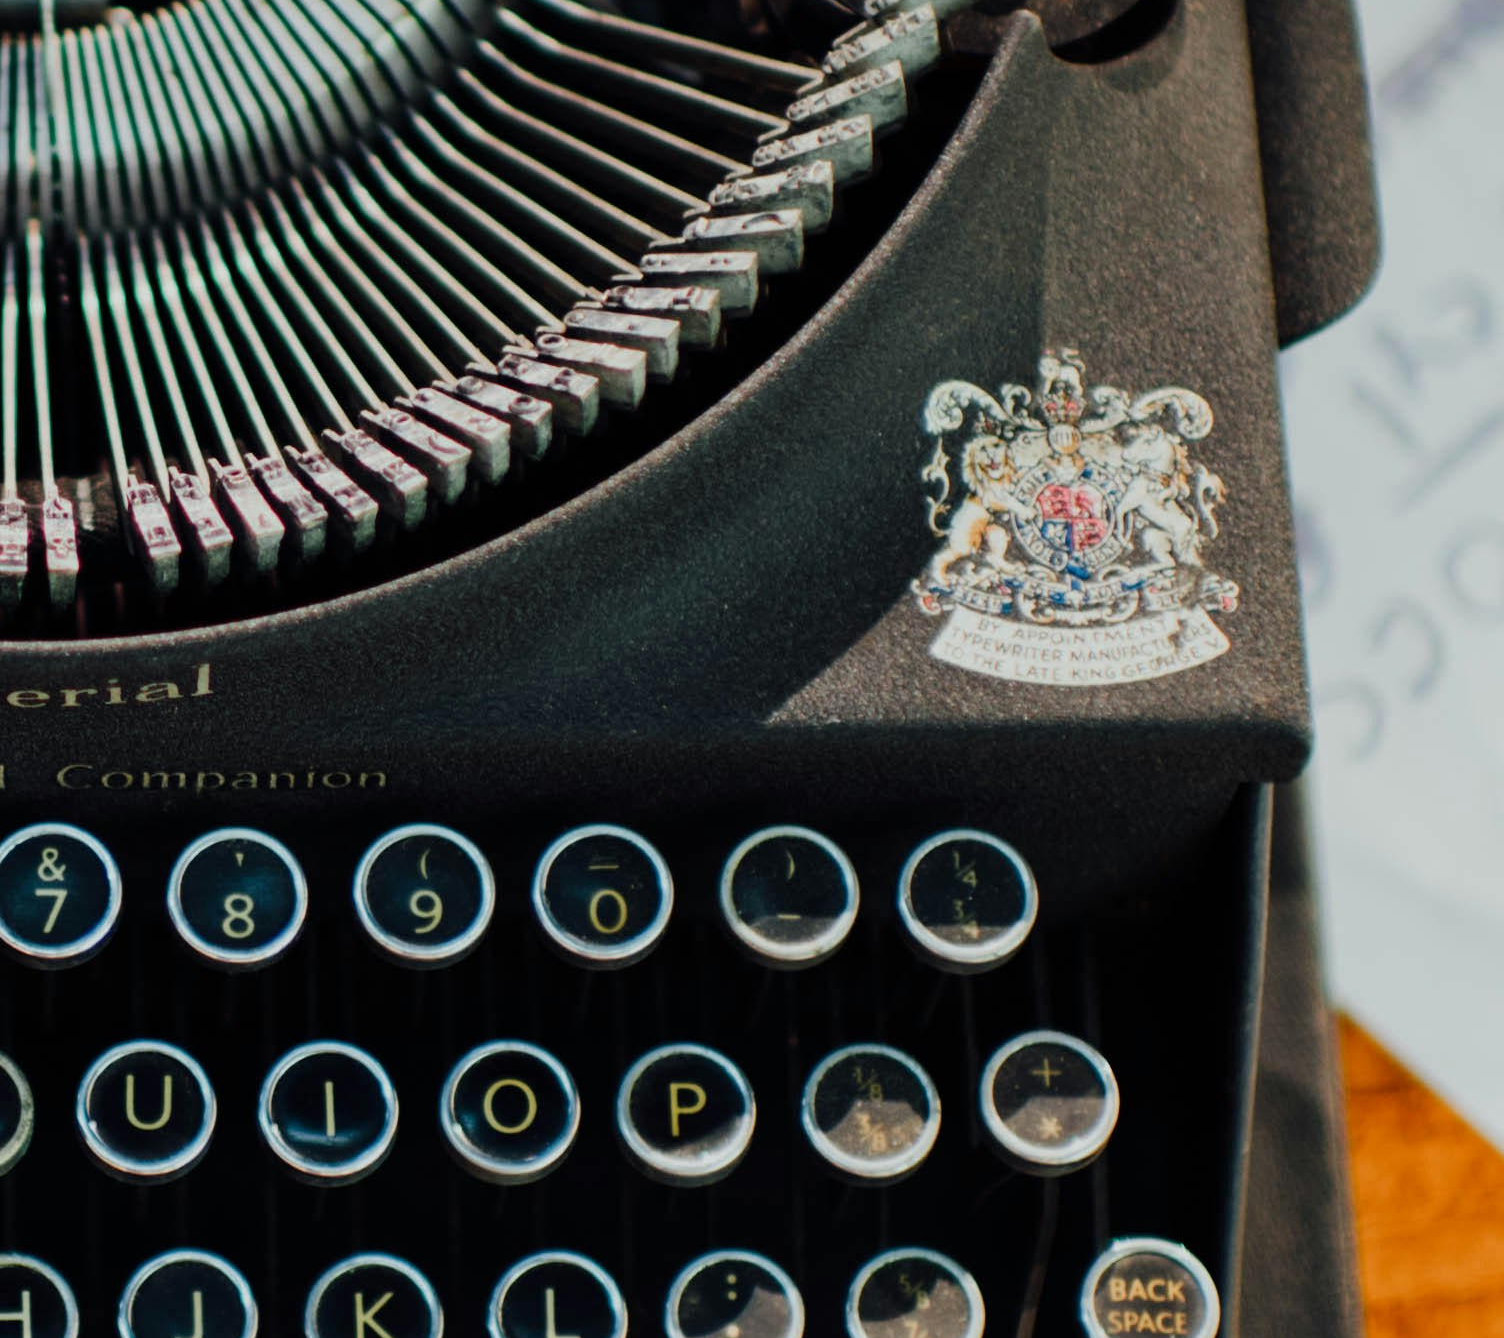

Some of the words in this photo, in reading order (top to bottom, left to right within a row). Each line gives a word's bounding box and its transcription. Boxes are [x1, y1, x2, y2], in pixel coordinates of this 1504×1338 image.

[951, 625, 1065, 663] TYPEWRITER
[56, 764, 388, 795] Companion
[36, 847, 67, 882] &
[34, 888, 69, 934] 7
[222, 893, 256, 939] 8
[408, 889, 444, 934] 9
[124, 1073, 174, 1131] U
[323, 1079, 336, 1138] I
[481, 1077, 538, 1135] O
[668, 1081, 707, 1138] P
[1108, 1277, 1187, 1304] BACK
[1105, 1311, 1188, 1336] SPACE
